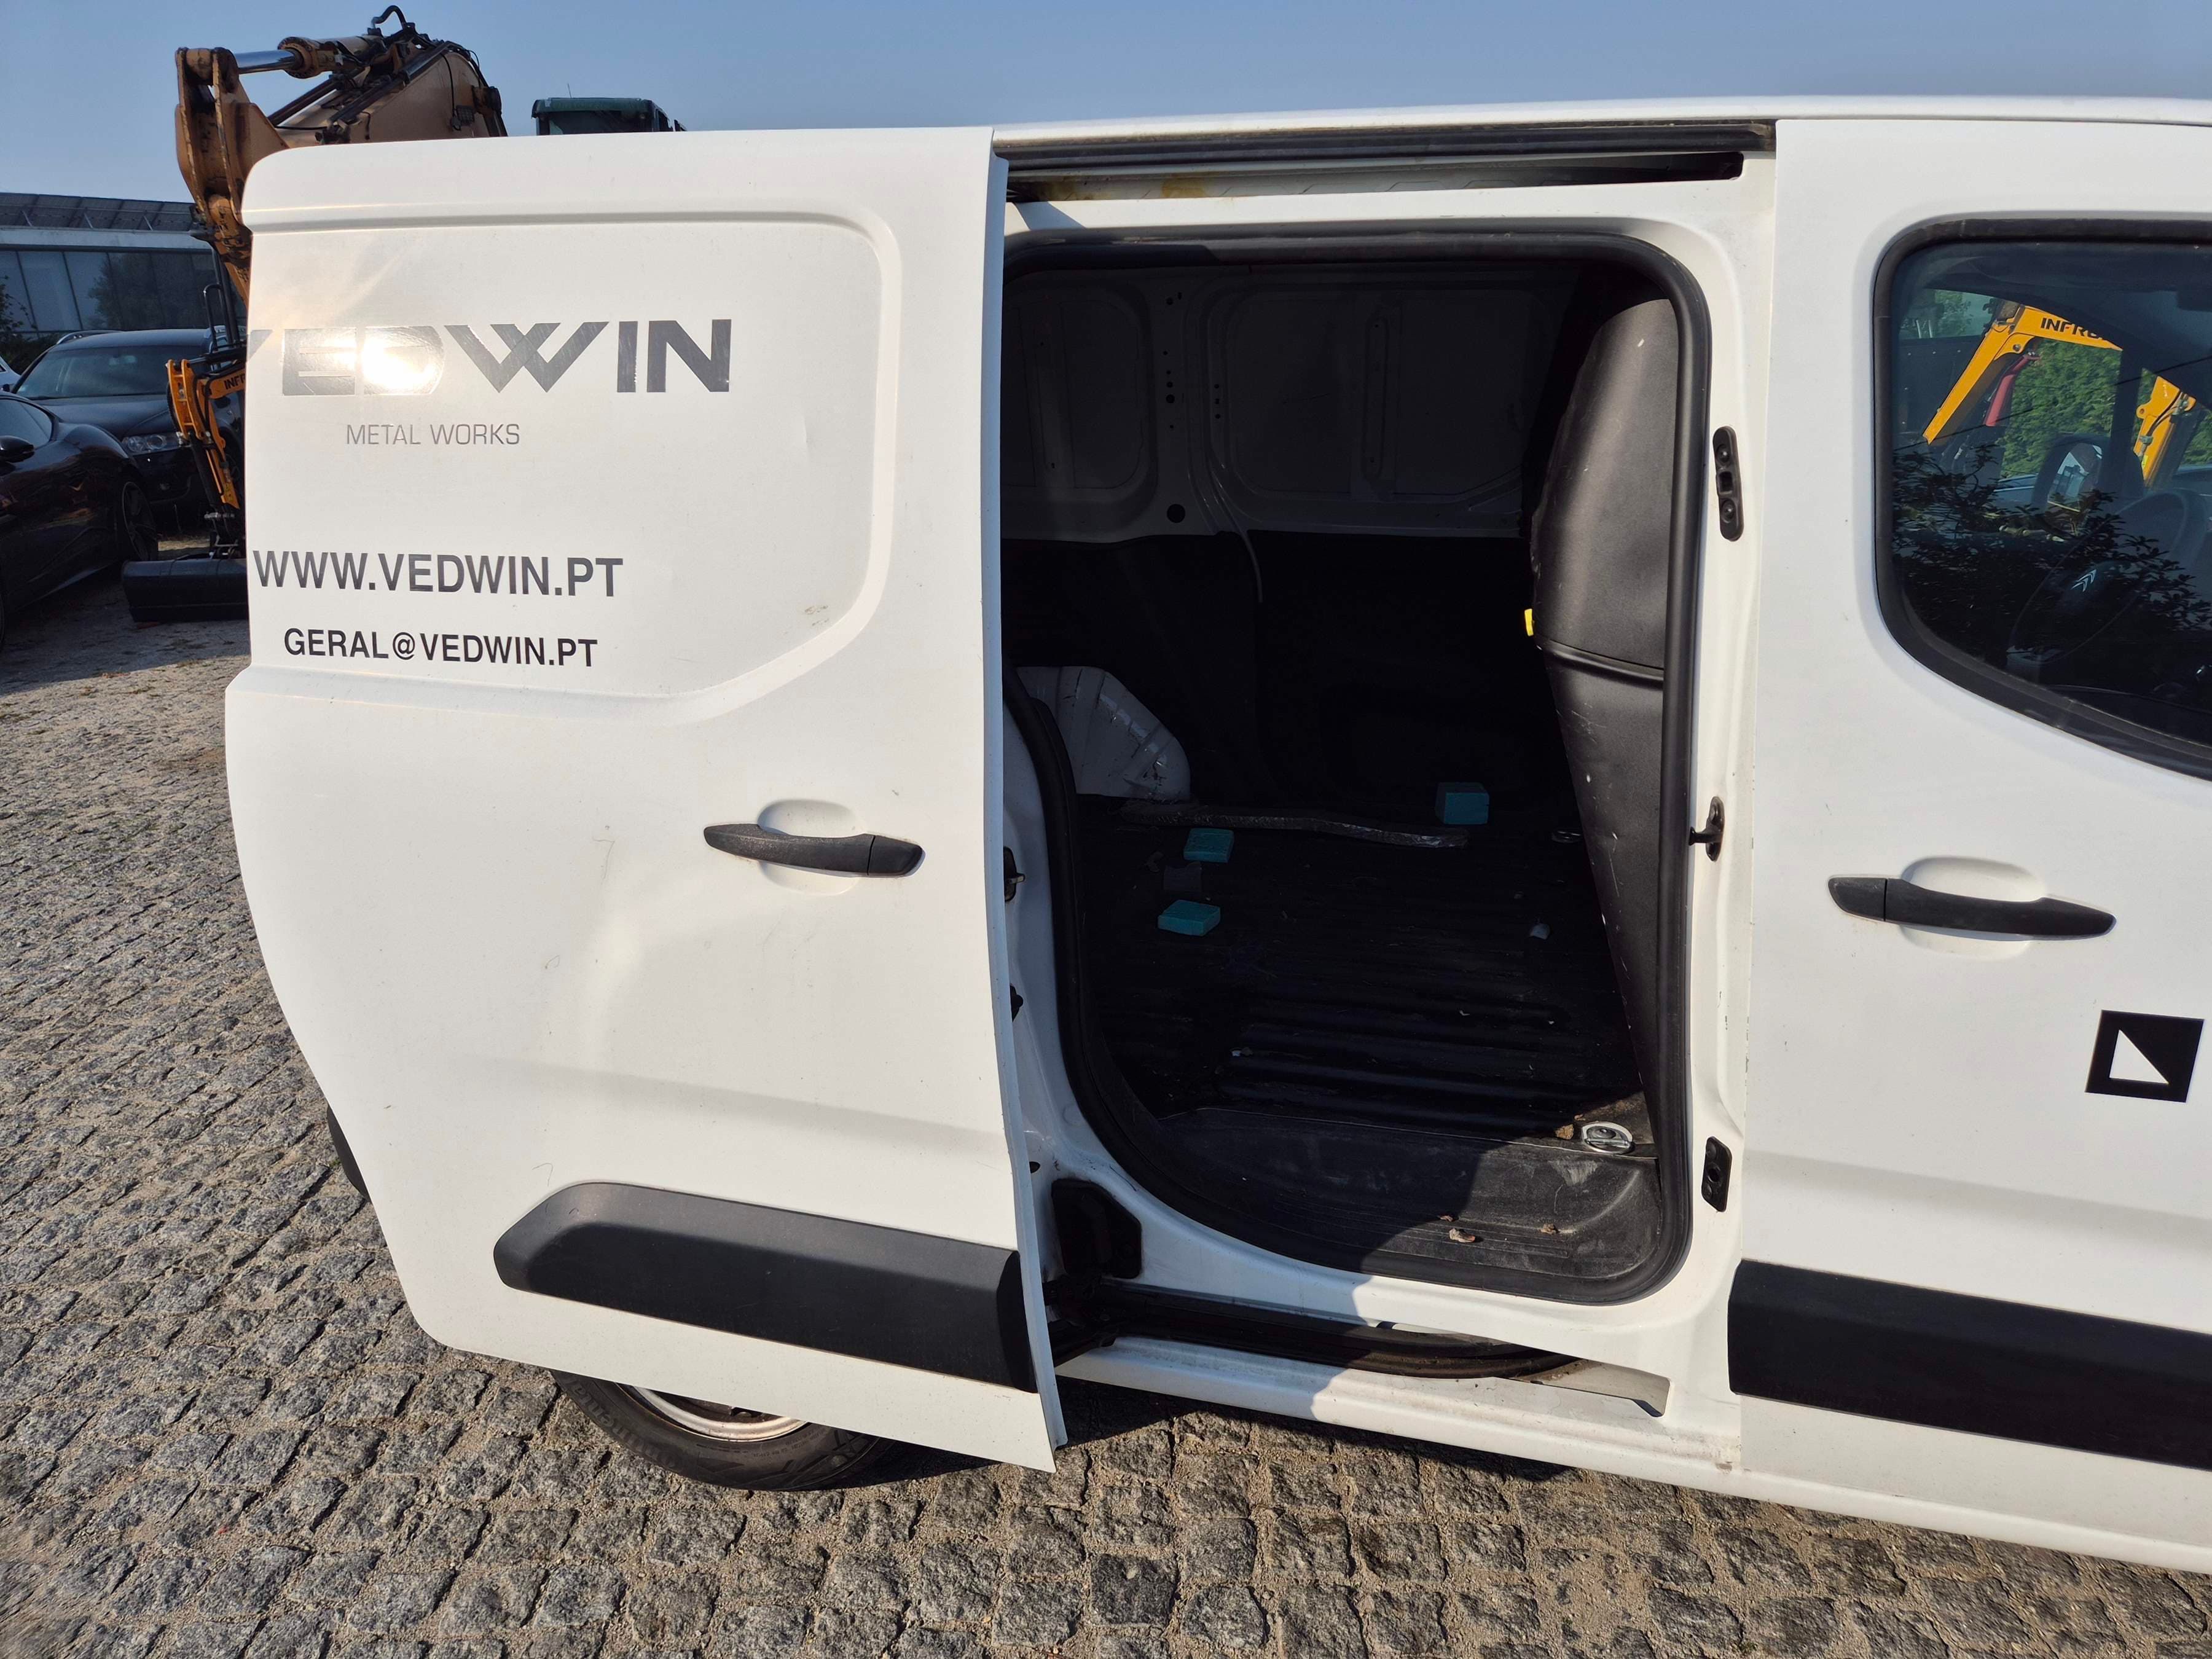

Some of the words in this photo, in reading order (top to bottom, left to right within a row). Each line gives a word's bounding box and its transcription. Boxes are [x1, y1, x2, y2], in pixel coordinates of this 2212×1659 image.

[346, 423, 422, 445] METAL
[429, 423, 520, 445] WORKS
[253, 549, 624, 597] WWW.VEDWIN.PT
[284, 627, 598, 667] GERAL@VEDWIN.PT
